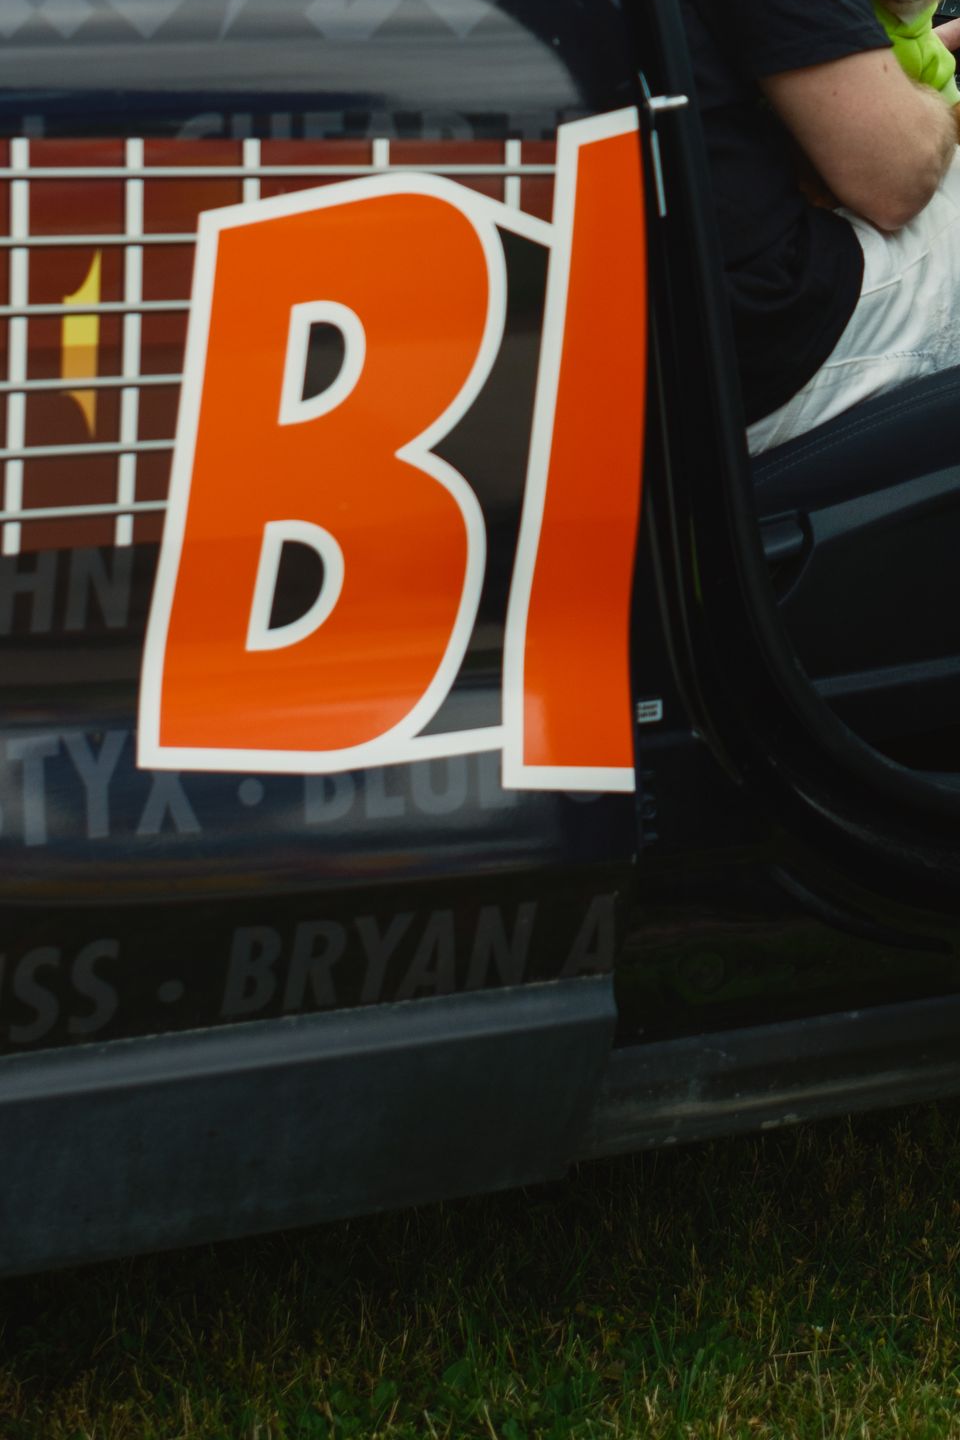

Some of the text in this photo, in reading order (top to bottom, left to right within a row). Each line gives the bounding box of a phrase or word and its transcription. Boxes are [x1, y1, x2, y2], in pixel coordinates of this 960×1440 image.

[0, 729, 203, 846] TYX
[0, 938, 119, 1042] SS
[220, 901, 540, 1016] BRYAN
